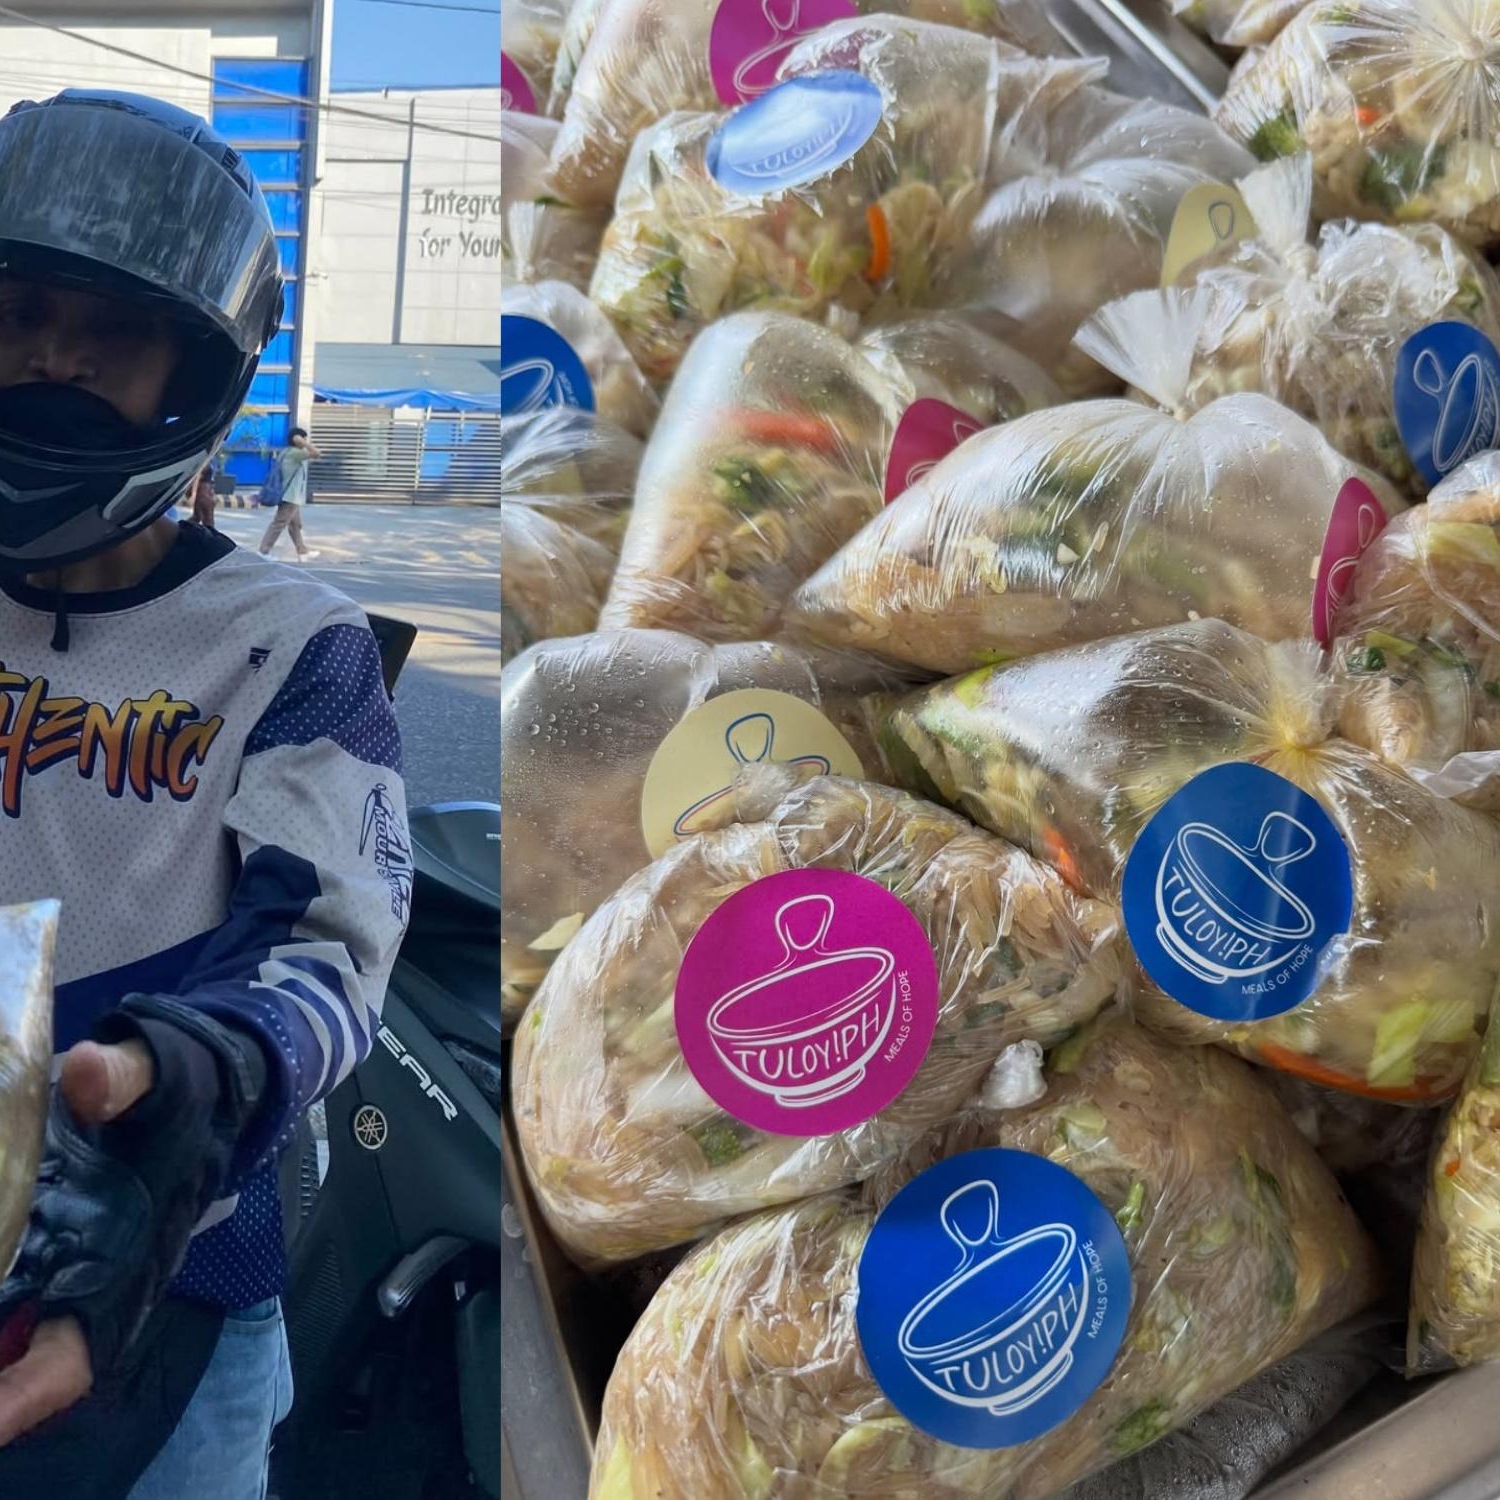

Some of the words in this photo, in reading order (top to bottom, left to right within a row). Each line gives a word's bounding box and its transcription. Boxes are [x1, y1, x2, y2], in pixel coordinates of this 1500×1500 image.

[419, 227, 451, 258] for
[1164, 865, 1272, 967] TULOY!PH
[897, 969, 912, 1003] HOPE
[1241, 979, 1276, 996] MEALS
[1276, 968, 1293, 985] OF
[1290, 943, 1314, 973] HOPE
[902, 1003, 914, 1023] OF
[732, 1002, 881, 1080] TULOY!PH
[883, 1025, 911, 1064] MEALS
[376, 1020, 459, 1121] EAR
[1082, 1239, 1103, 1275] HOPE
[1096, 1276, 1109, 1295] OF
[933, 1281, 1078, 1392] TULOY!PH
[1087, 1296, 1109, 1339] MEALS
